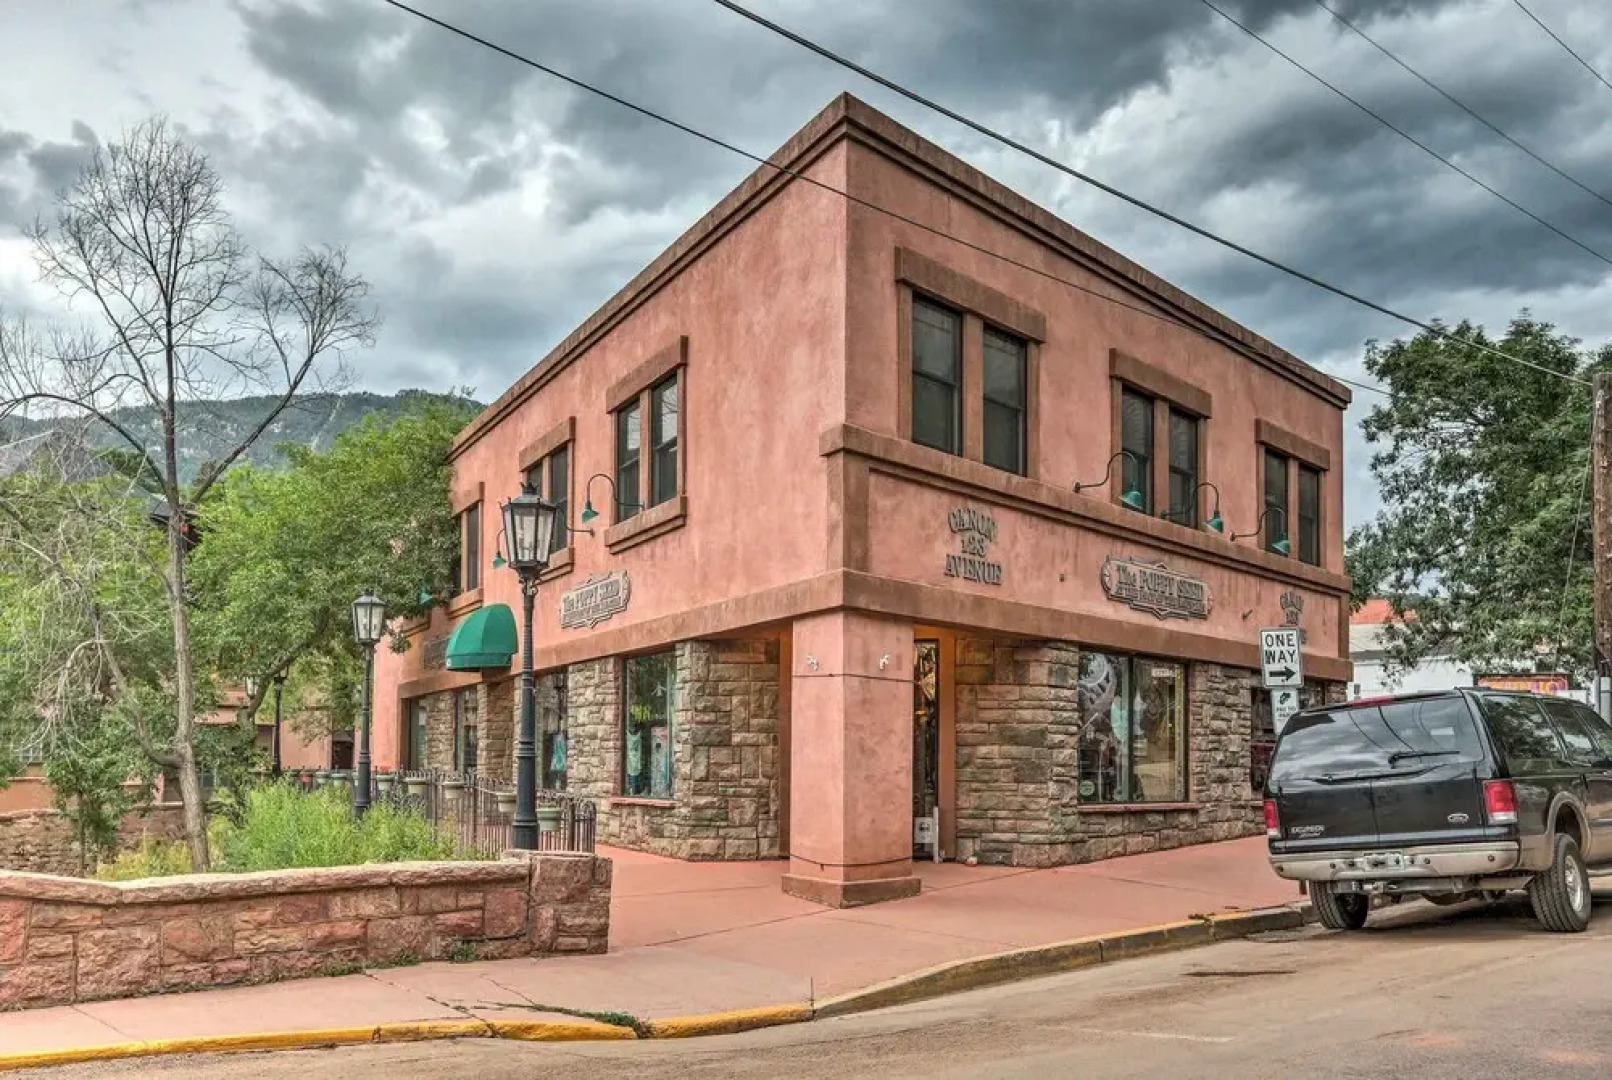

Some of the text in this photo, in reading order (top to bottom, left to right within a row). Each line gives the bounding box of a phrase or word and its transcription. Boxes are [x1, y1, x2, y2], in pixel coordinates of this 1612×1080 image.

[943, 554, 1002, 586] AVENUE
[1264, 633, 1296, 647] ONE
[1264, 649, 1297, 665] WAY
